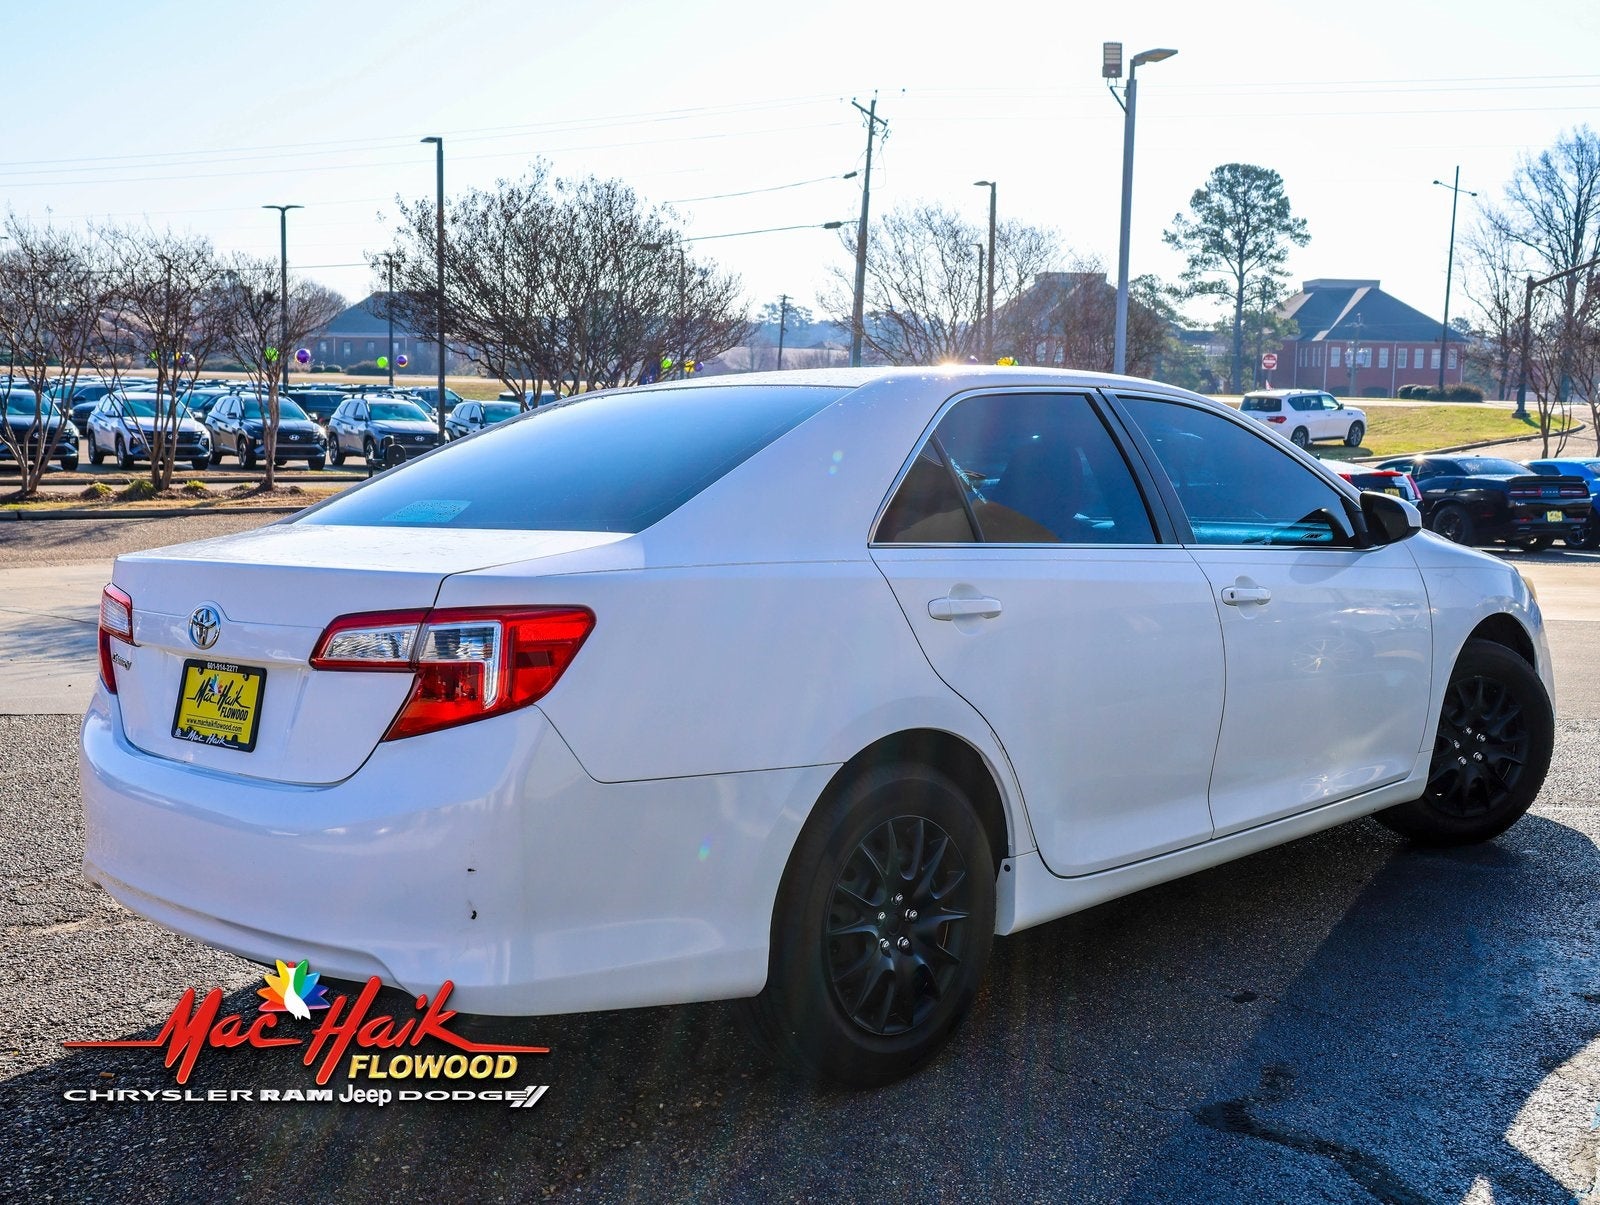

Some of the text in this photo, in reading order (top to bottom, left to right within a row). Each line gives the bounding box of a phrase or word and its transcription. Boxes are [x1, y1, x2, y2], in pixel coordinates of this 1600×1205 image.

[186, 677, 251, 711] Mac Haik
[220, 706, 249, 721] FLOWOOD
[180, 731, 237, 748] Mac Haik
